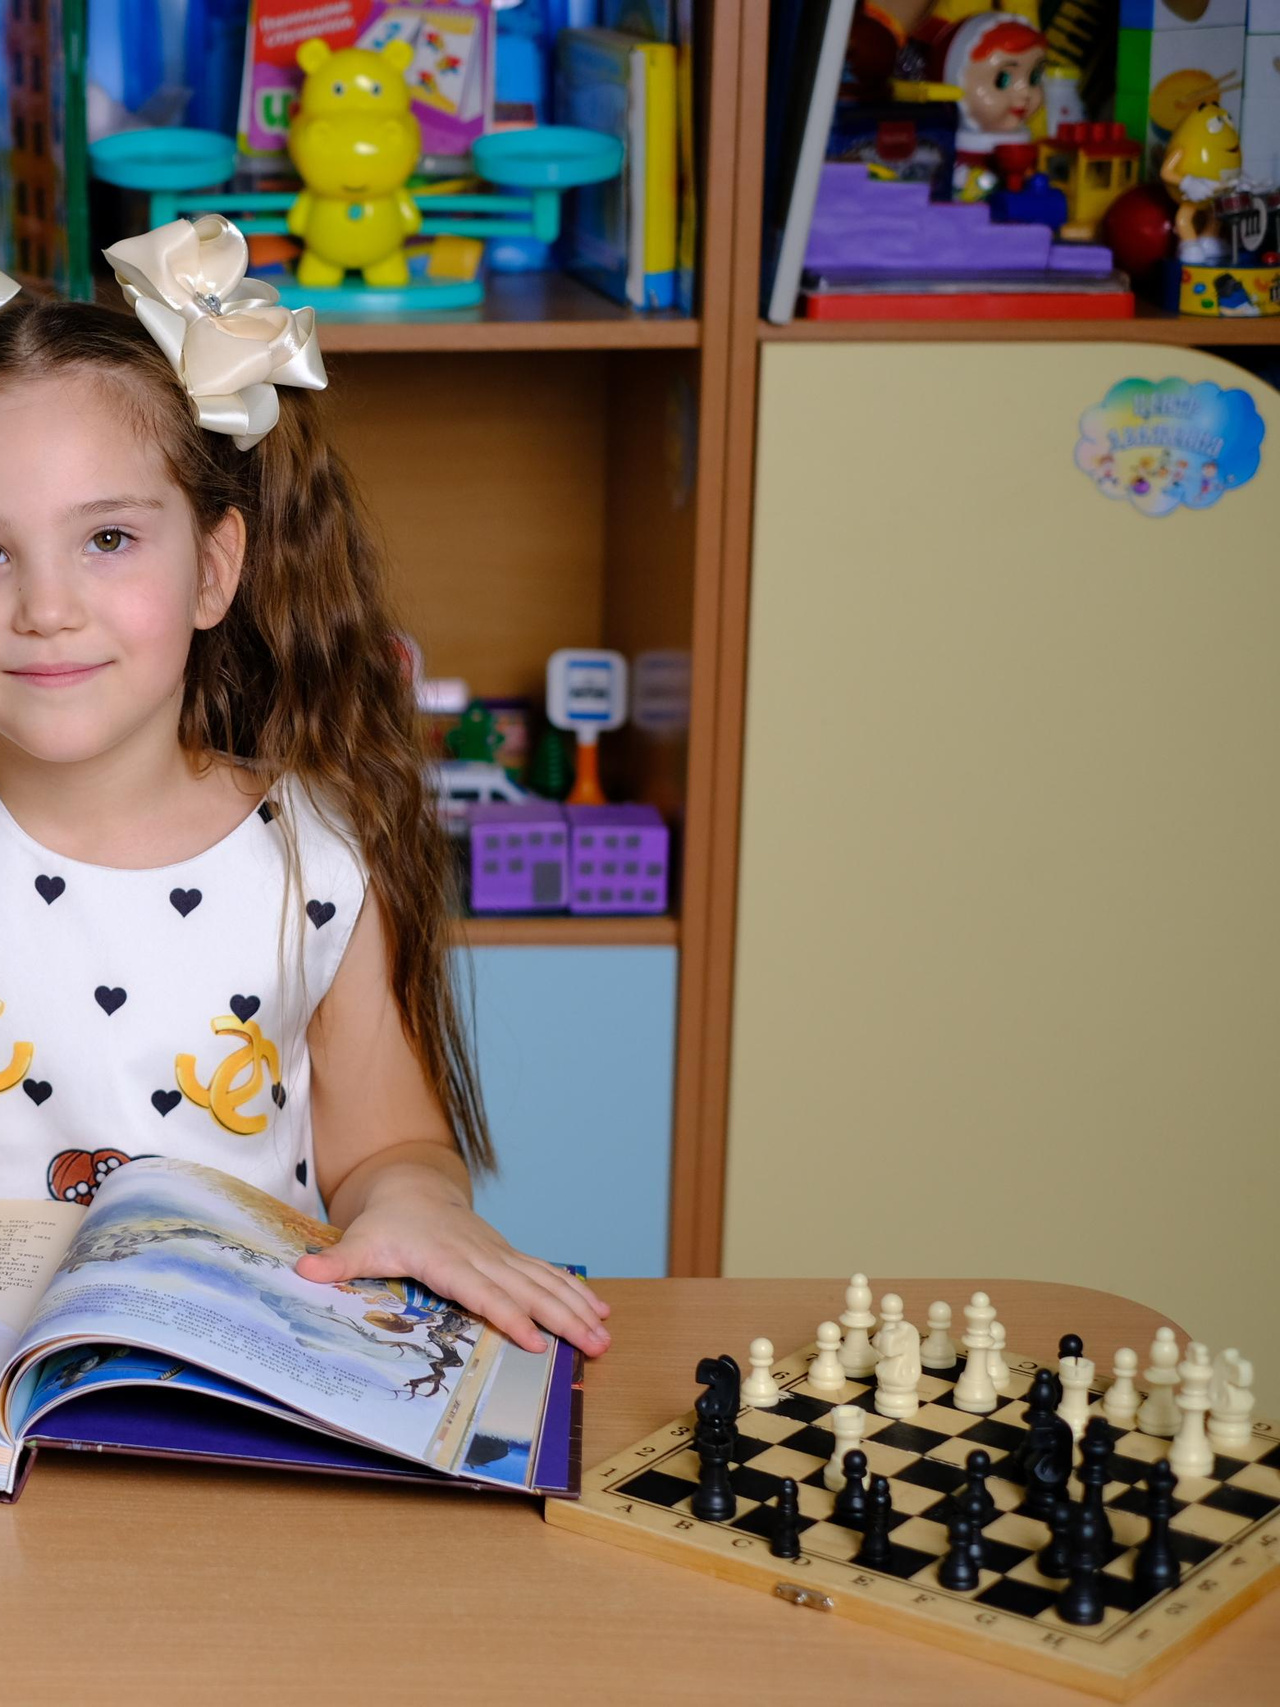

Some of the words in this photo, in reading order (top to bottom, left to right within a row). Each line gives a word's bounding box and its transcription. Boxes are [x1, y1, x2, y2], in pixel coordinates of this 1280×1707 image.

[771, 1370, 791, 1381] 6
[670, 1426, 691, 1437] 3
[634, 1446, 656, 1457] 2
[600, 1467, 617, 1478] 1
[614, 1502, 634, 1514] A
[673, 1519, 695, 1530] B
[730, 1538, 754, 1549] C
[789, 1556, 813, 1567] D
[850, 1575, 874, 1587] E
[974, 1612, 998, 1626] G
[1041, 1632, 1067, 1649] H
